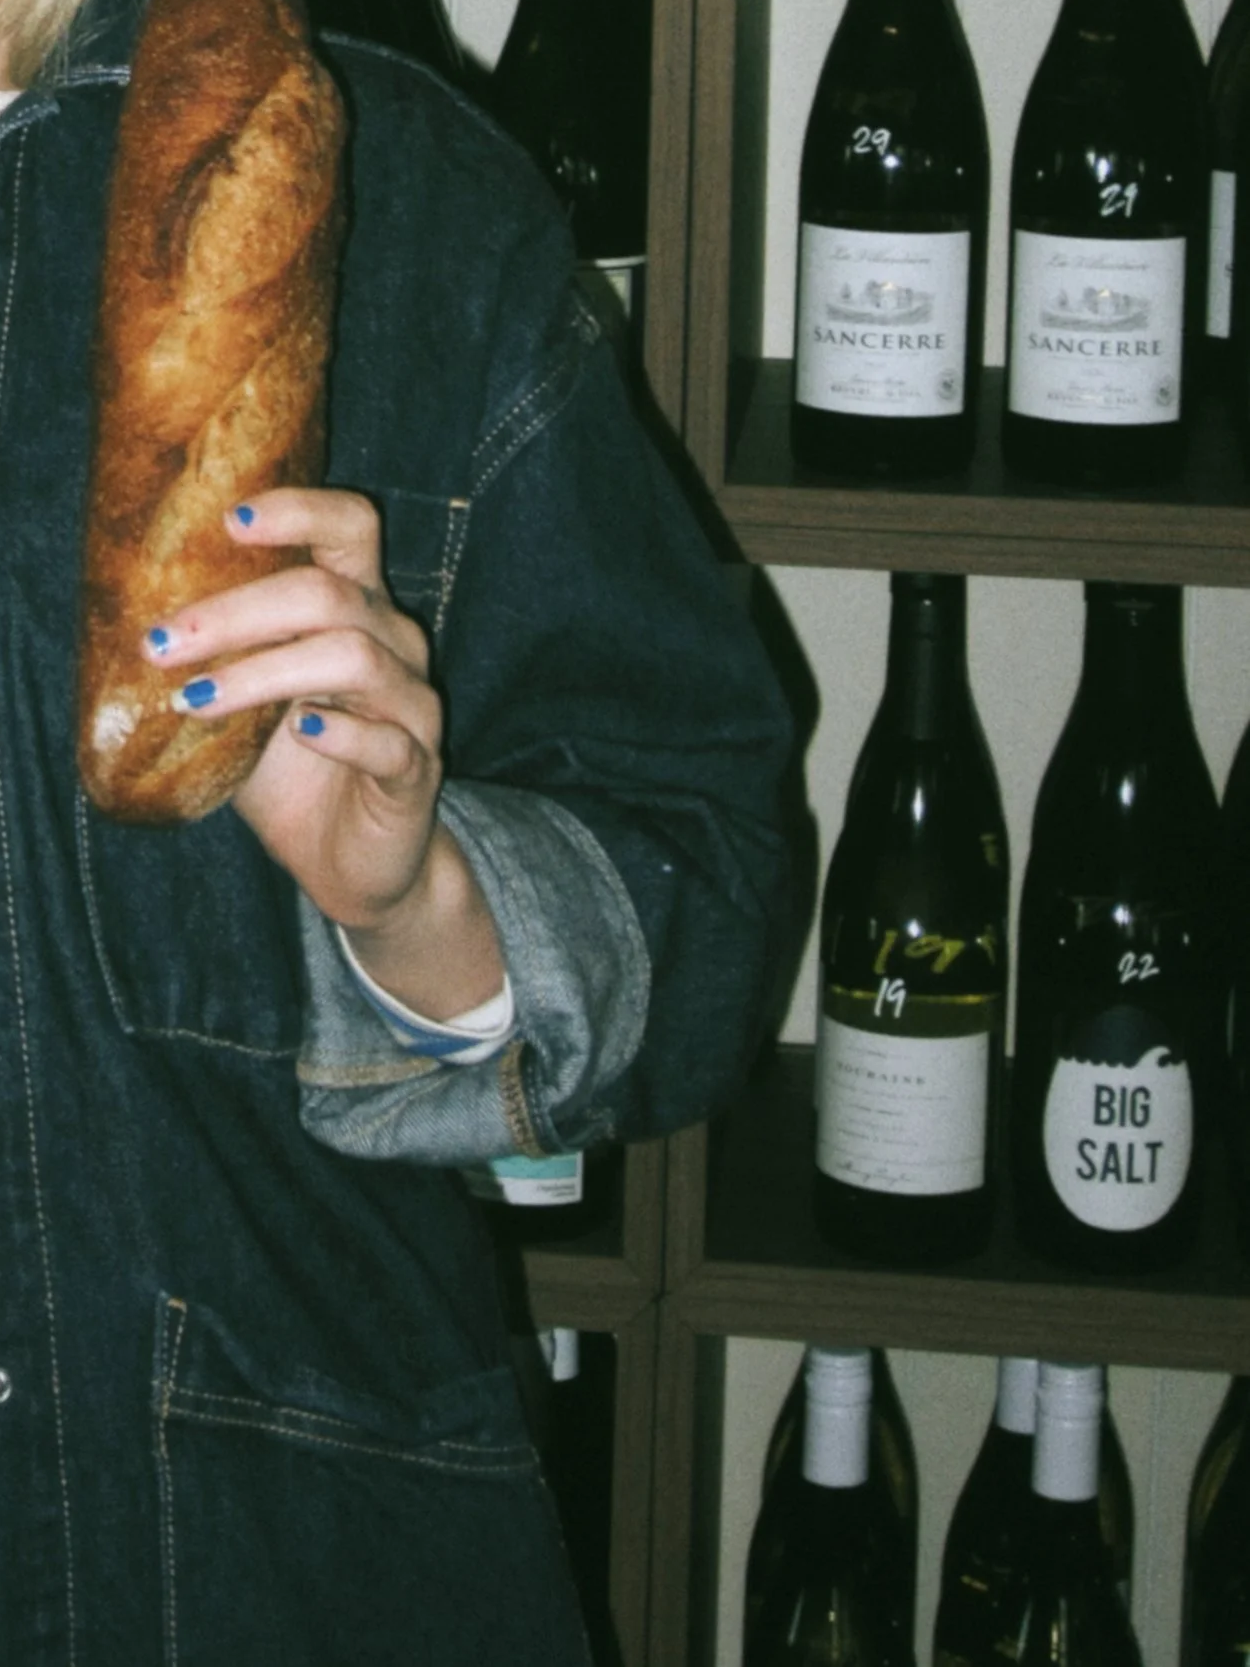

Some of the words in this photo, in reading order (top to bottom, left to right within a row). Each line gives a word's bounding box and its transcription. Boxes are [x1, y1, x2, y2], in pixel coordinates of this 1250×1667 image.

[852, 126, 891, 155] 29
[1098, 182, 1138, 218] 29
[813, 325, 947, 351] SANCERRE
[1027, 332, 1162, 357] SANCERRE
[1117, 950, 1161, 985] 22
[873, 977, 906, 1019] 19
[1092, 1084, 1151, 1128] BIG
[1075, 1137, 1165, 1185] SALT
